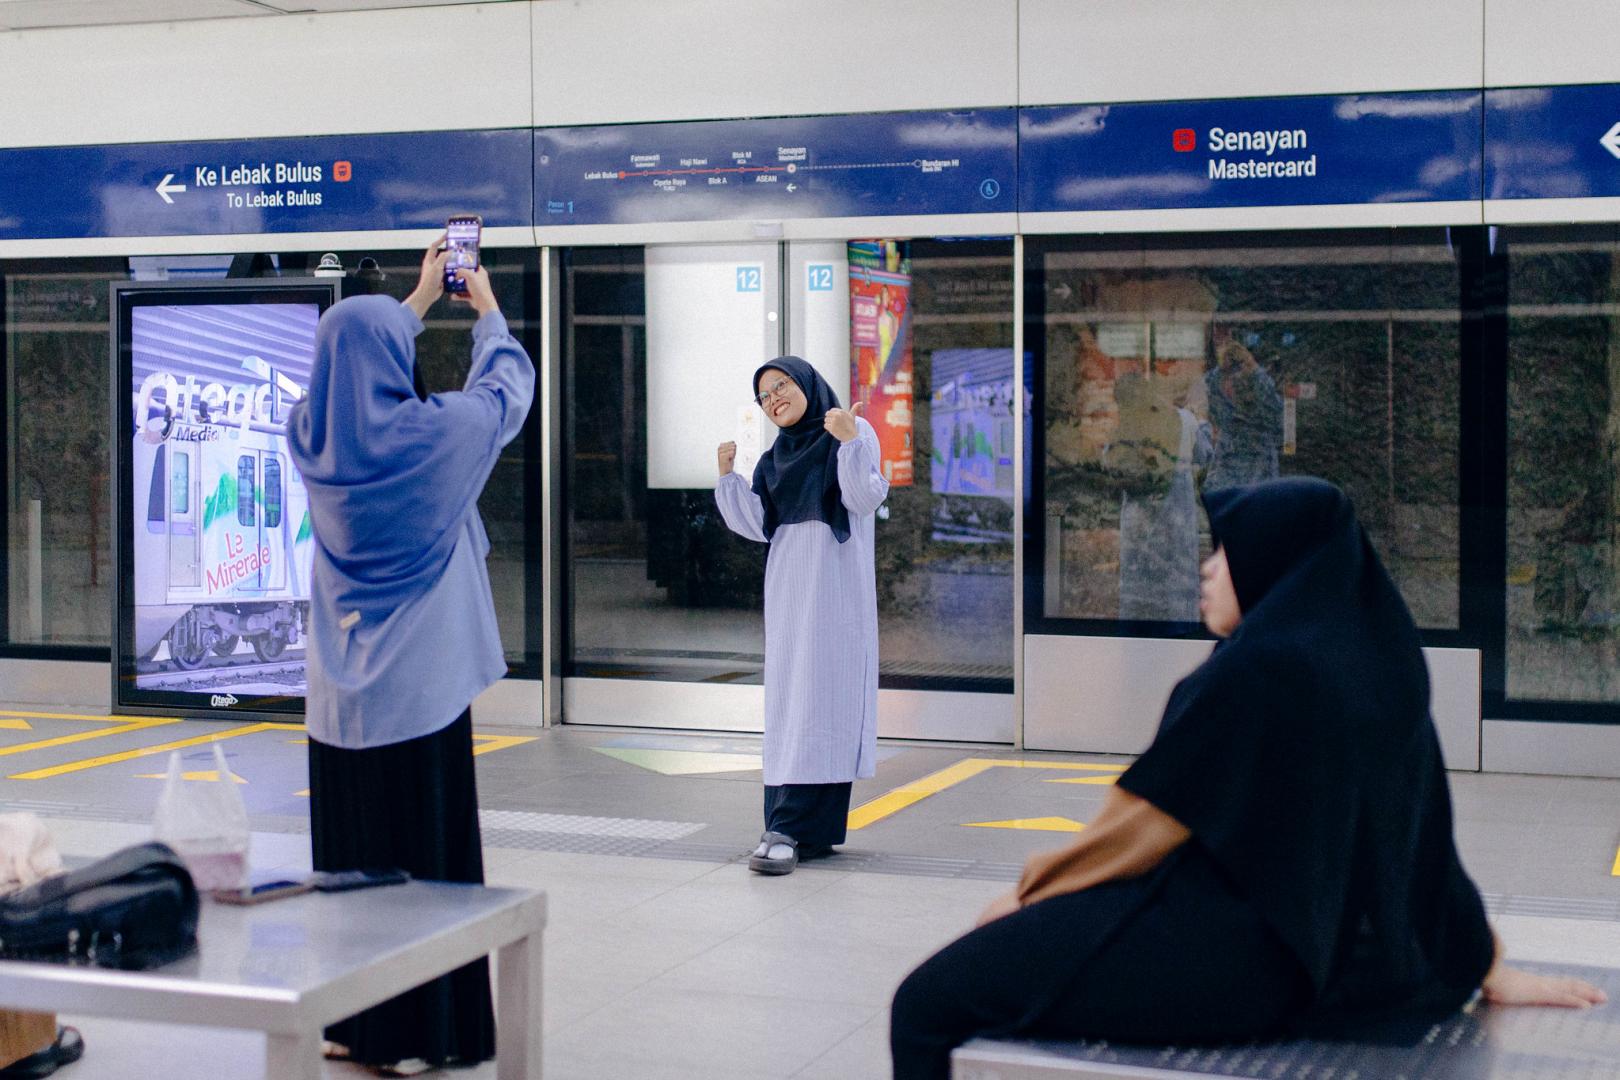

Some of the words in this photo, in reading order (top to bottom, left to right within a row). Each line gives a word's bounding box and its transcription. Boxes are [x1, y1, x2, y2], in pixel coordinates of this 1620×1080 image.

[1208, 127, 1307, 156] Senayan
[196, 167, 216, 187] Ke
[222, 164, 270, 185] Lebak
[275, 162, 322, 183] Bulus
[1208, 154, 1317, 180] Mastercard
[227, 192, 243, 208] To
[246, 190, 284, 207] Lebak
[286, 189, 322, 206] Bulus
[567, 201, 573, 213] 1
[738, 269, 759, 290] 12
[810, 268, 831, 288] 12
[226, 532, 244, 559] Le
